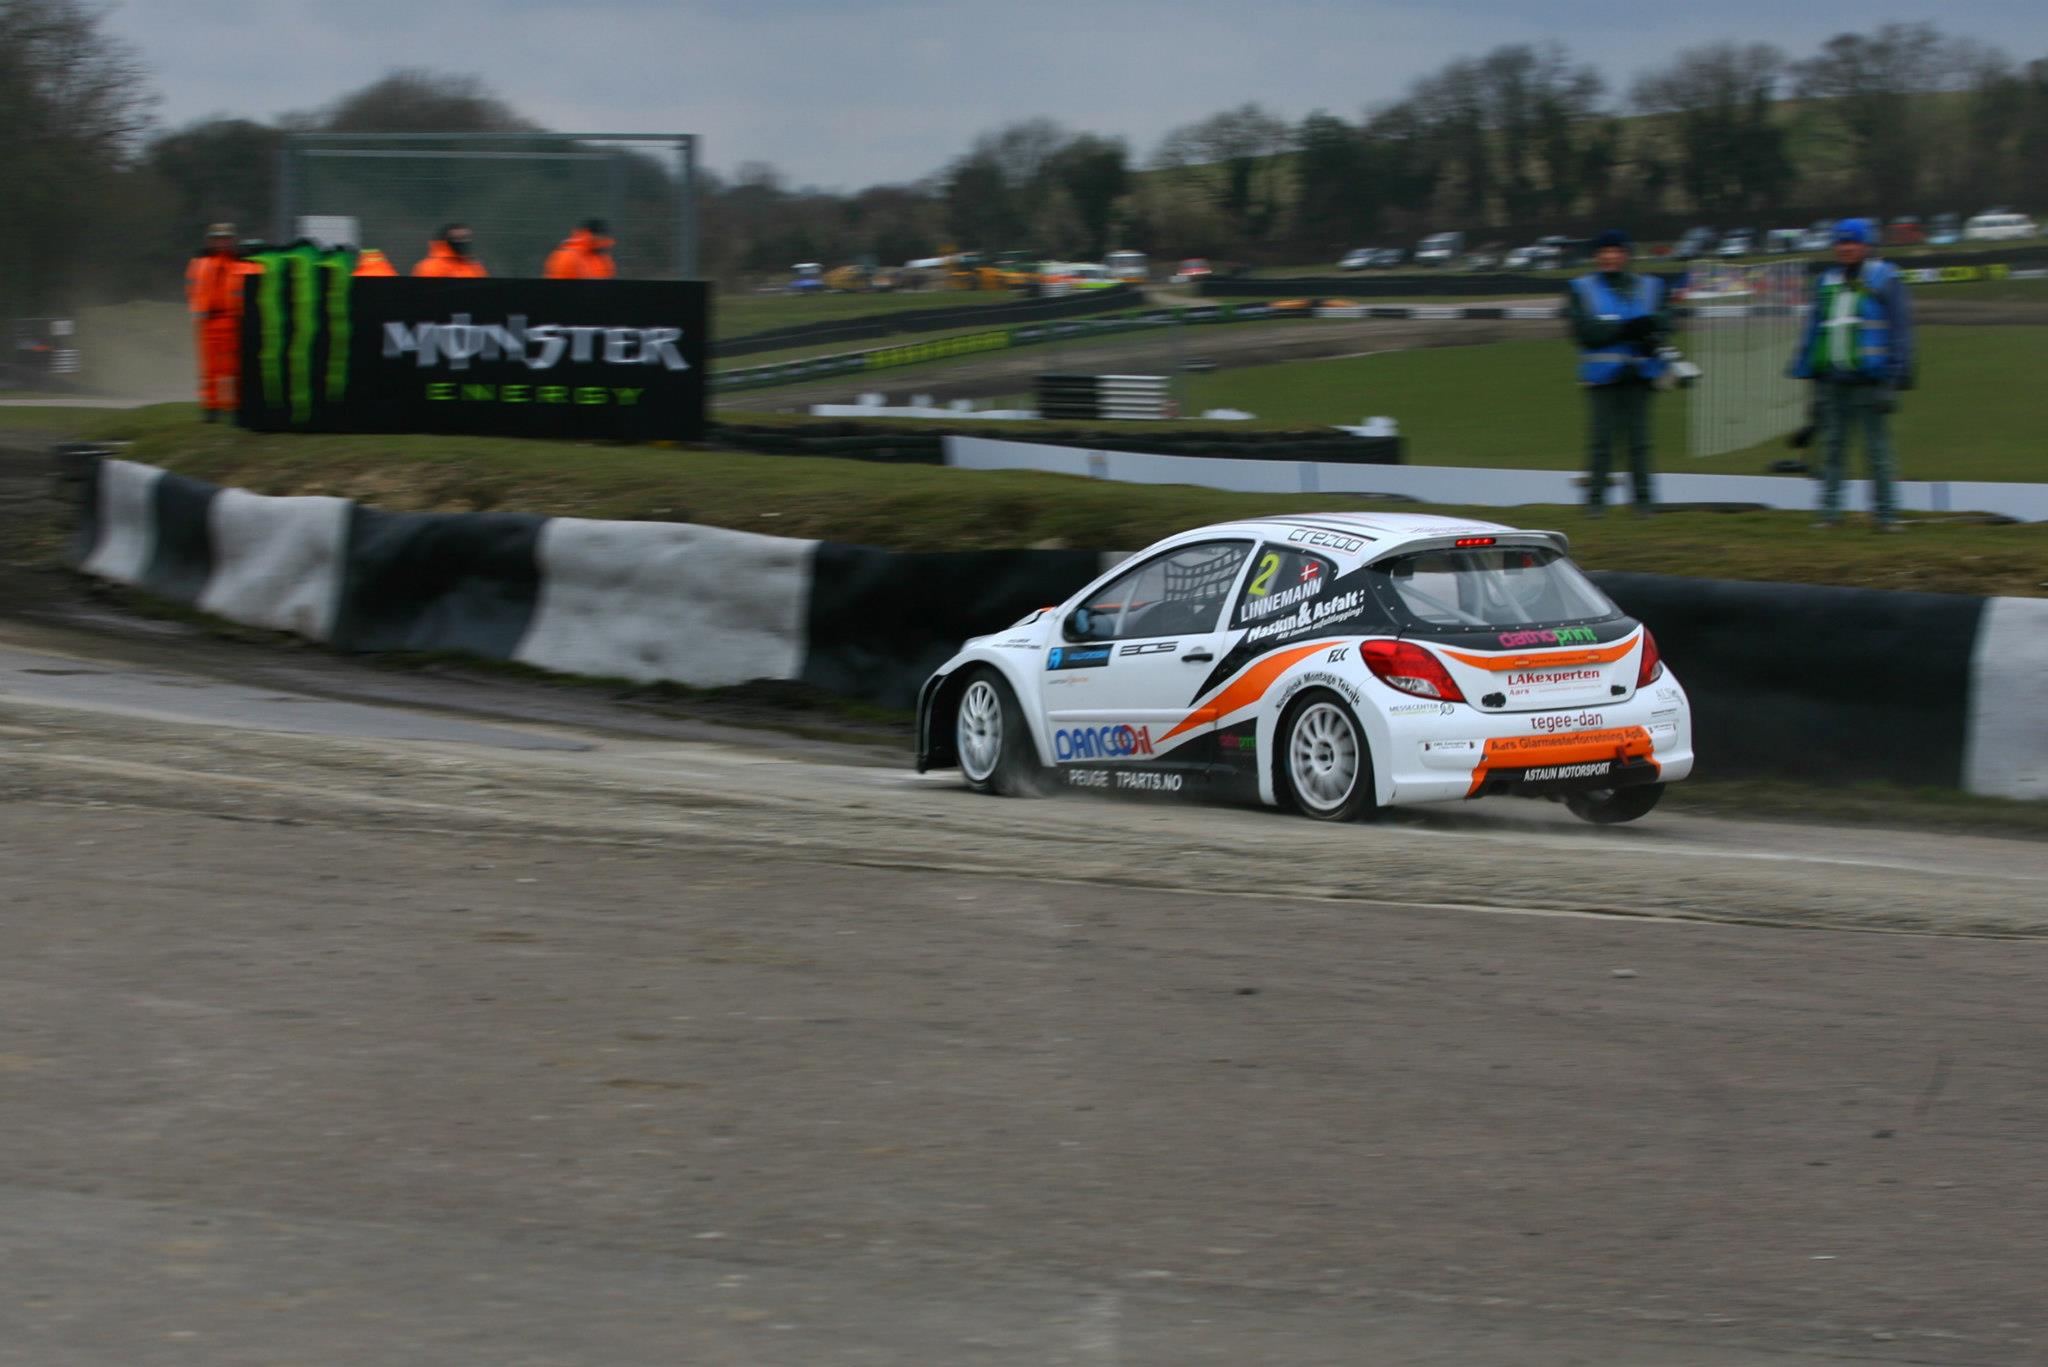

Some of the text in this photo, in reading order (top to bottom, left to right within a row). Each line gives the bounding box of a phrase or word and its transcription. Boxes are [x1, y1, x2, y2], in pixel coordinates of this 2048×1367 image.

[383, 312, 689, 370] MONSTER
[426, 382, 645, 405] ENERGY
[1248, 552, 1281, 596] 2
[1241, 577, 1322, 622] LINNEMANN
[1247, 615, 1296, 643] Maskin
[1298, 601, 1312, 628] &
[1303, 672, 1336, 685] Montage
[1337, 678, 1360, 707] Teknik
[1508, 670, 1600, 685] LAKexperten
[1531, 711, 1603, 732] tegee-dan
[1116, 771, 1183, 791] TPARTS.NO
[1524, 763, 1611, 782] ASTAUN MOTORSPORT
